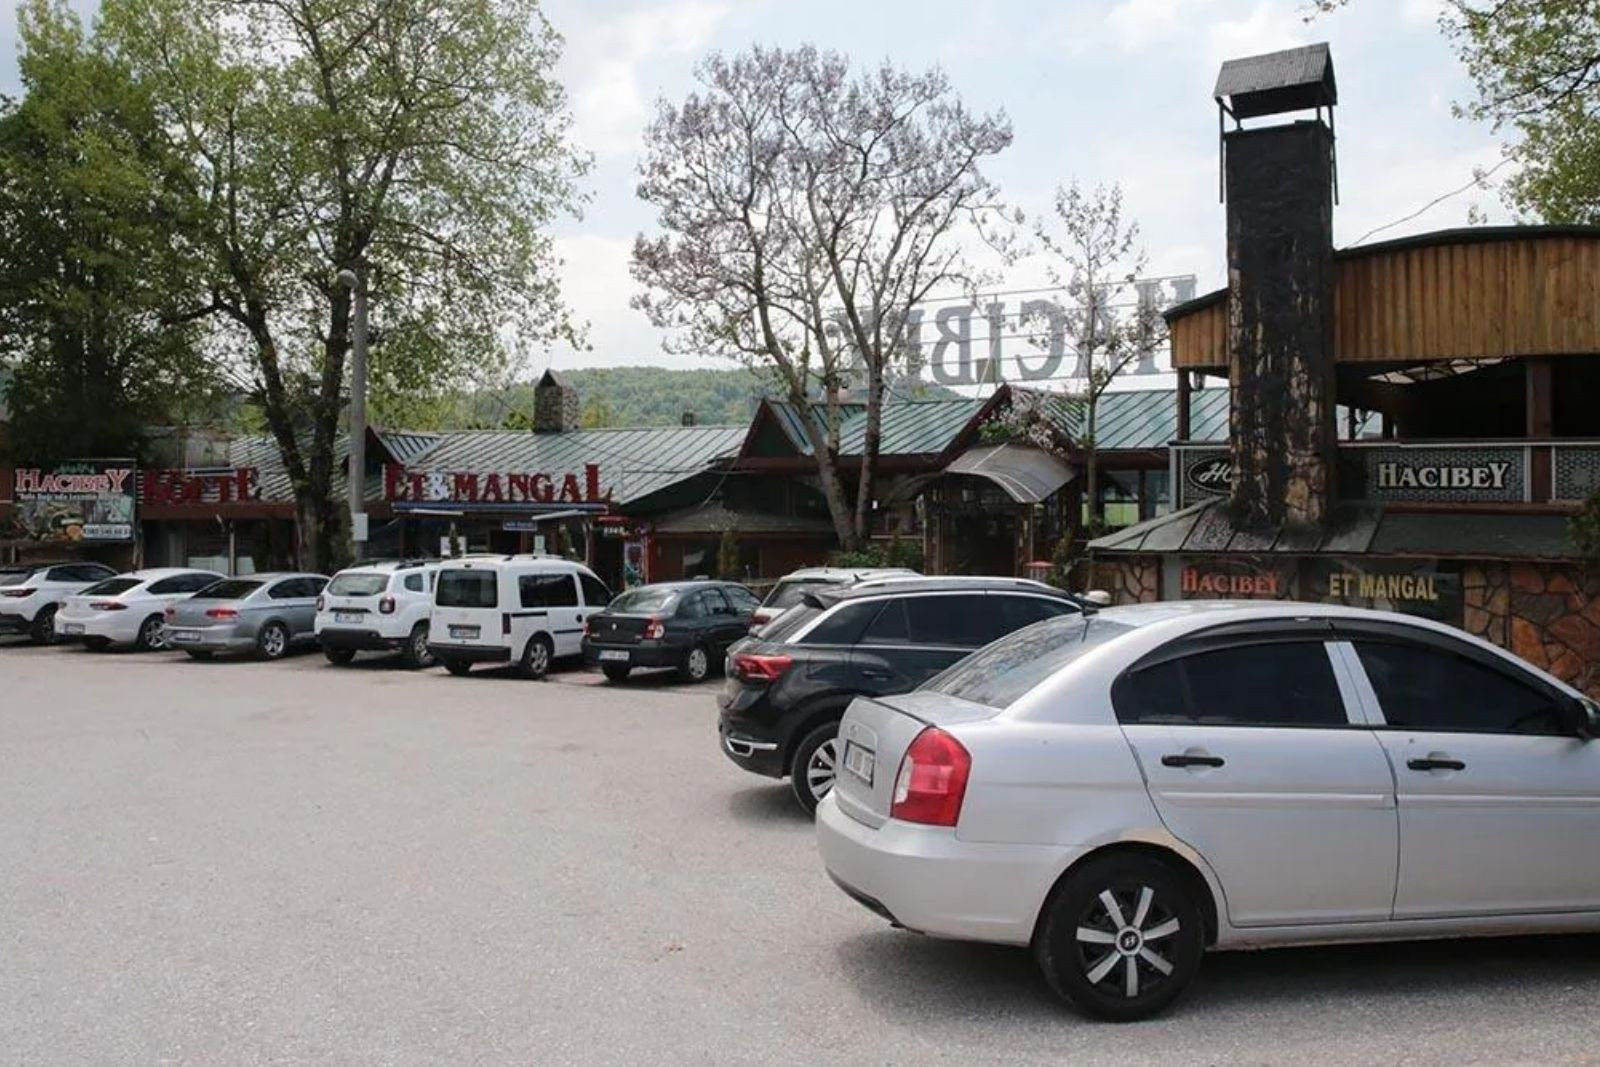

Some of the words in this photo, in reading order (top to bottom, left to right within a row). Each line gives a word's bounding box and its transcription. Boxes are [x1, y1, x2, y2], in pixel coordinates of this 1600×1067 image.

[1378, 462, 1510, 488] HACIBEY
[1328, 573, 1352, 597] ET
[1359, 573, 1439, 600] MANGAL
